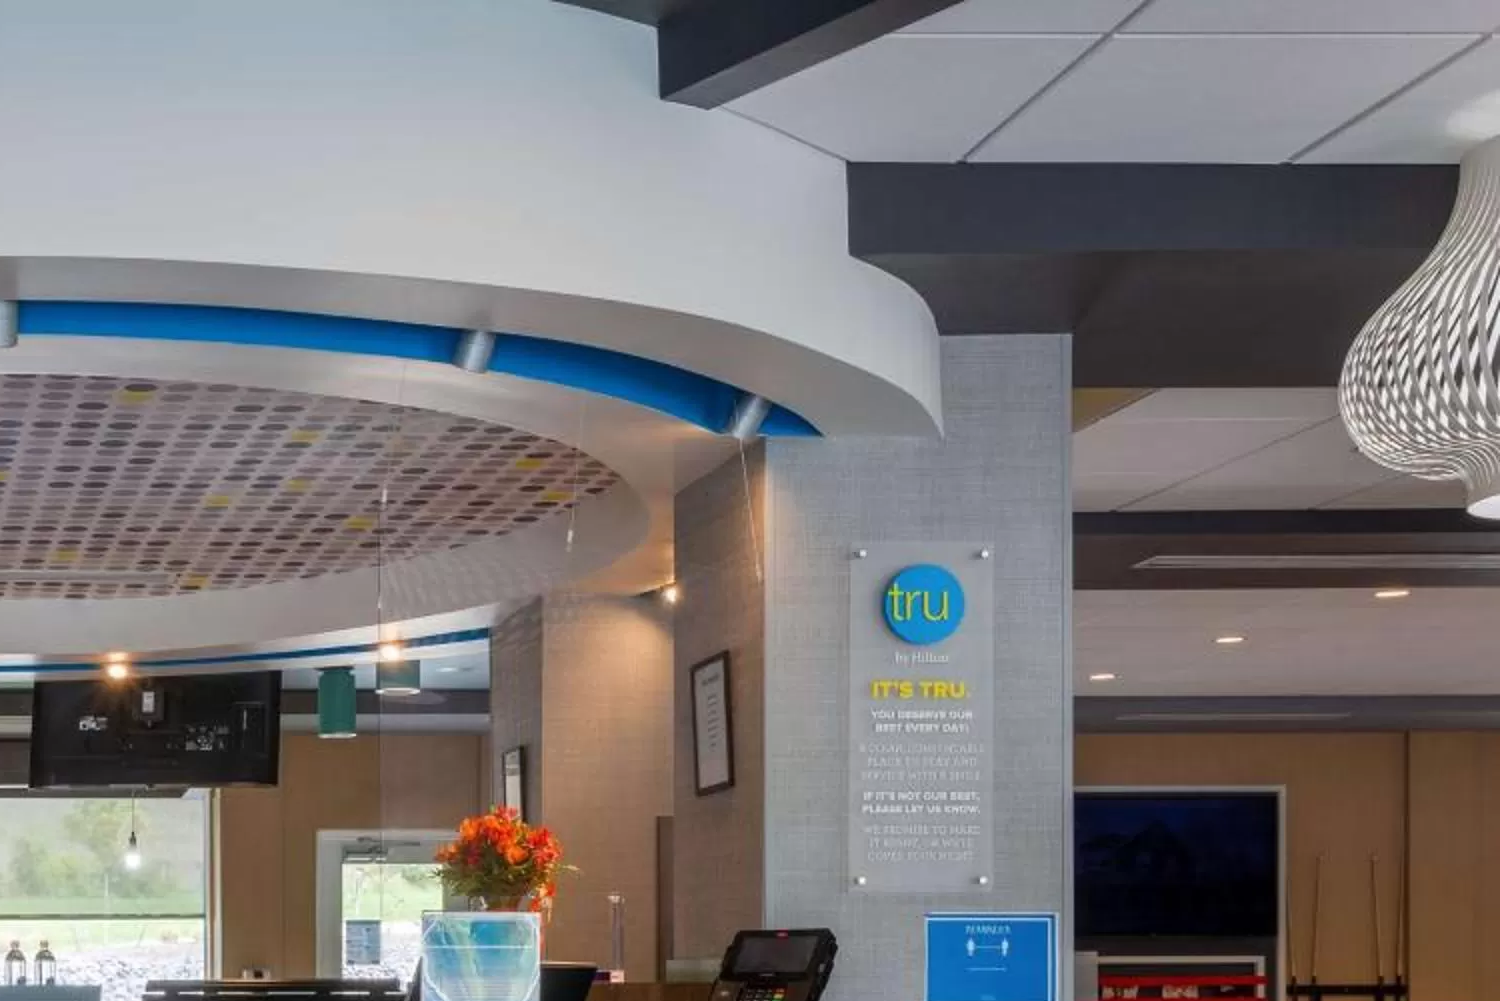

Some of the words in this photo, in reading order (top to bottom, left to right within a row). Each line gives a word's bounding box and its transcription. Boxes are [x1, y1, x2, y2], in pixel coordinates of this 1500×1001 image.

[888, 583, 948, 620] tru
[912, 652, 949, 664] Hilton
[872, 681, 914, 698] IT'S
[919, 681, 971, 698] TRU.
[871, 710, 894, 720] YOU
[898, 710, 947, 720] DESERVE
[949, 710, 972, 720] OUR
[875, 723, 901, 733] BEST
[905, 723, 940, 733] EVERY
[863, 791, 874, 801] IF
[875, 791, 896, 801] IT'S
[897, 791, 921, 801] NOT
[923, 791, 947, 801] OUR
[861, 804, 903, 814] PLEASE
[904, 804, 924, 814] LET
[927, 804, 942, 814] US
